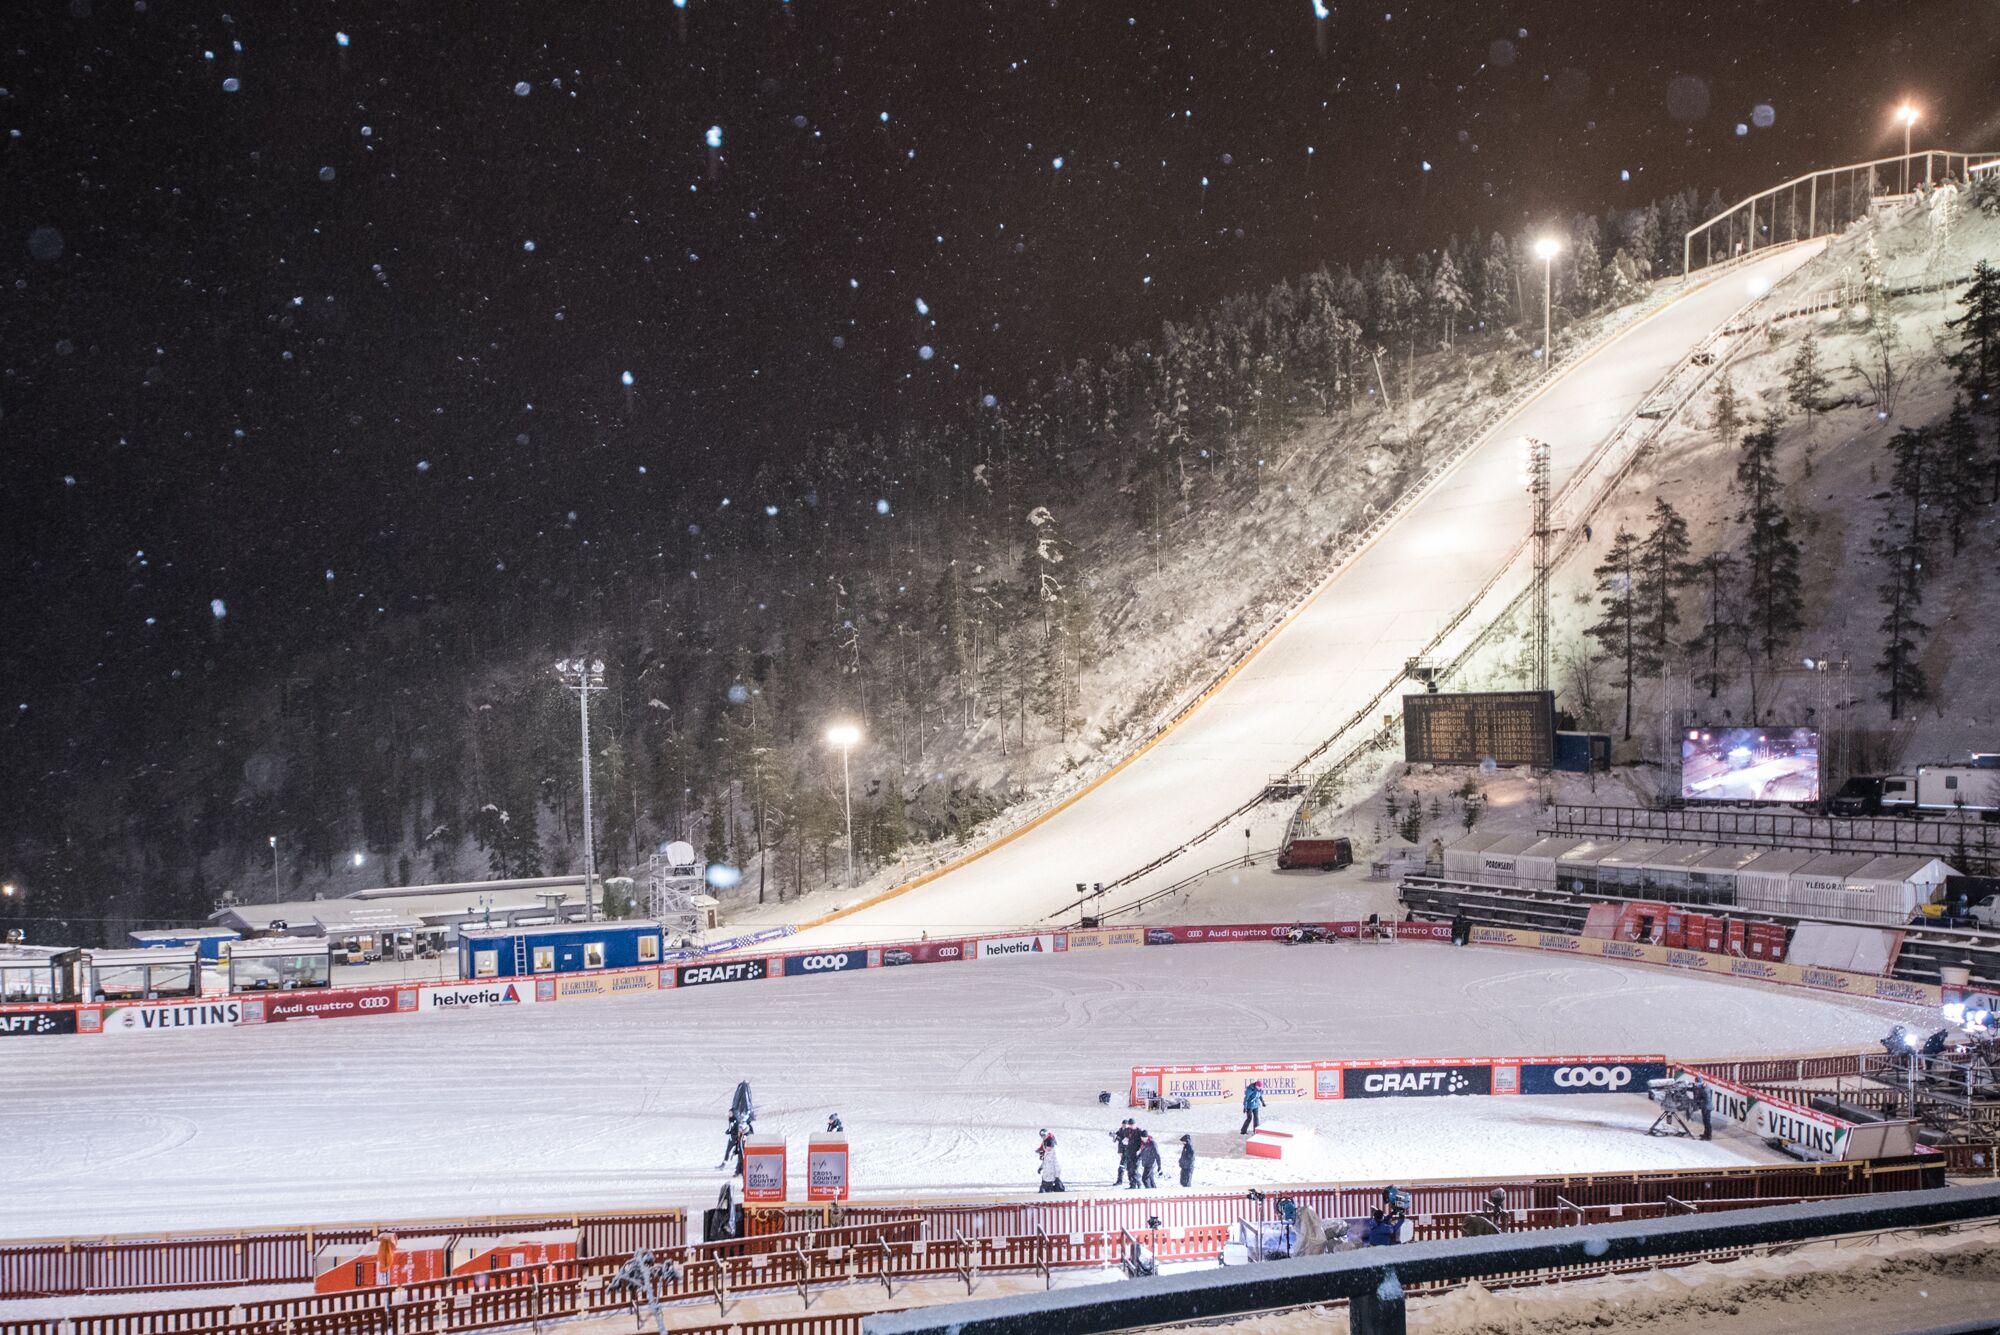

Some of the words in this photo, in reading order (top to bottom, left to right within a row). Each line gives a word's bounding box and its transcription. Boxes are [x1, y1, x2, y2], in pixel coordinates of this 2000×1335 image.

[1208, 928, 1230, 938] Audi
[1232, 928, 1267, 939] quattro
[986, 941, 1030, 956] helvetia
[802, 954, 848, 970] coop
[684, 964, 746, 984] CRAFT
[434, 990, 500, 1006] helvetia
[273, 1004, 303, 1014] Audi
[306, 1000, 354, 1014] quattro
[0, 1016, 36, 1032] AFT
[142, 1004, 239, 1029] VELTINS
[1170, 1080, 1180, 1092] LE
[1257, 1076, 1296, 1089] RUYÈRE
[1364, 1072, 1446, 1092] CRAFT
[1554, 1066, 1632, 1090] coop
[1714, 1090, 1746, 1122] TINS
[1769, 1110, 1833, 1154] VELTINS
